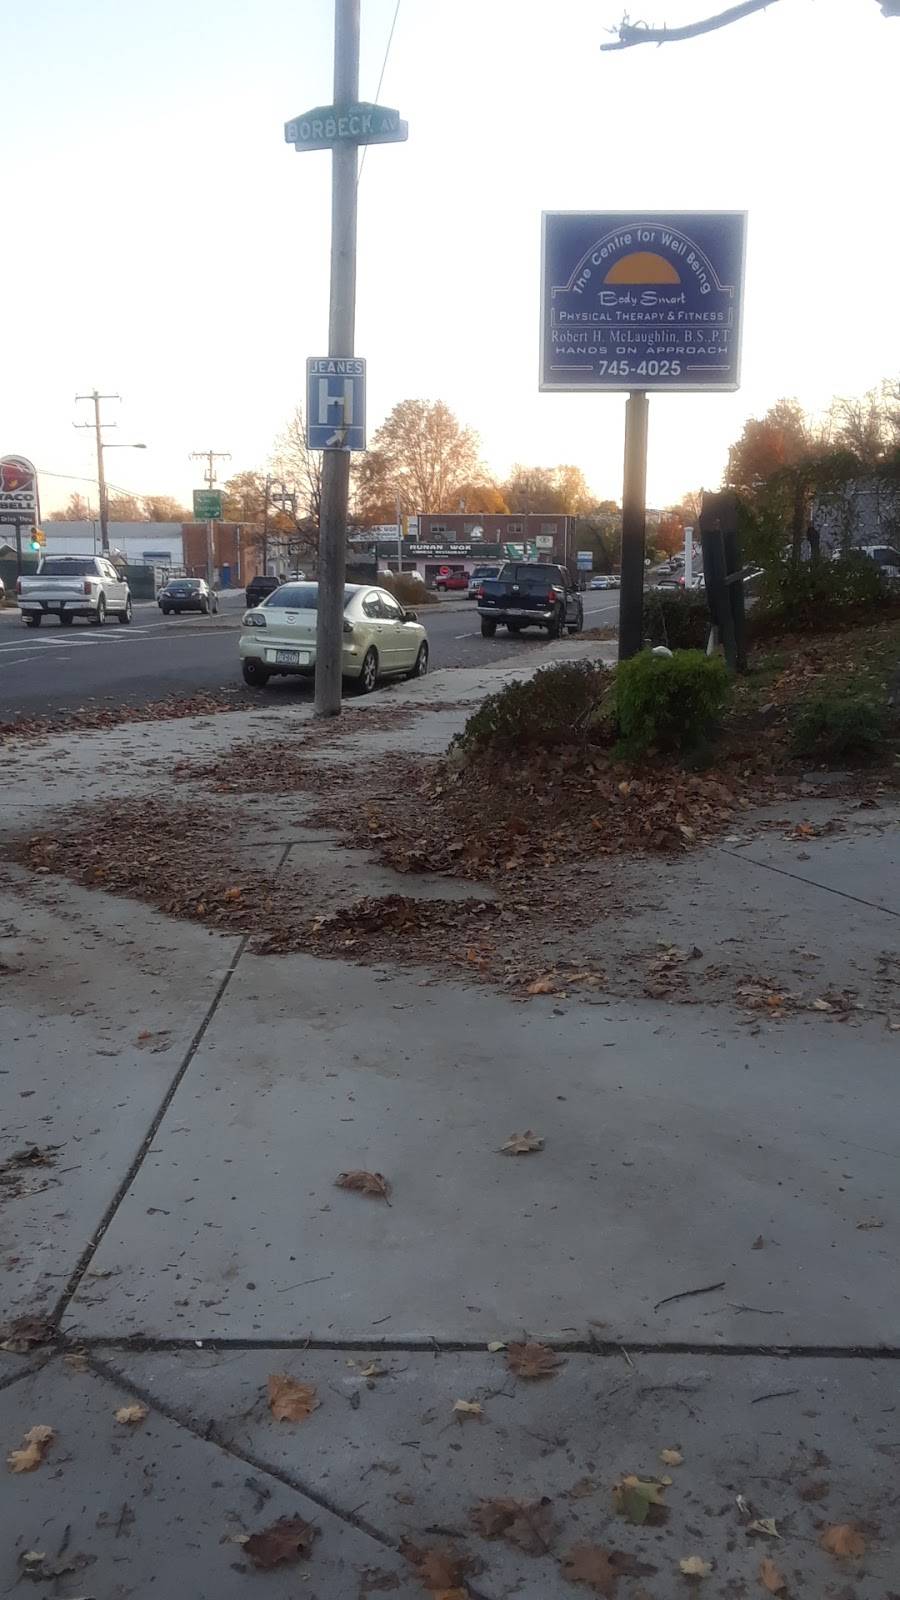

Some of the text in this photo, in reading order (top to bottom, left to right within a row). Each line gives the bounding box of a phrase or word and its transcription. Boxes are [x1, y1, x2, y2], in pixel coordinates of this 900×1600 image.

[287, 115, 373, 140] BORBECK
[573, 229, 711, 294] The Centre for Well Being
[598, 291, 686, 306] Body Smart
[559, 311, 724, 321] PHYSICAL THERAPY & FITNESS
[551, 330, 588, 343] Robert
[593, 330, 605, 343] H.
[610, 330, 679, 346] McLaughlin,
[311, 361, 363, 373] JEANES
[599, 360, 681, 376] 745-4025
[318, 378, 354, 424] H
